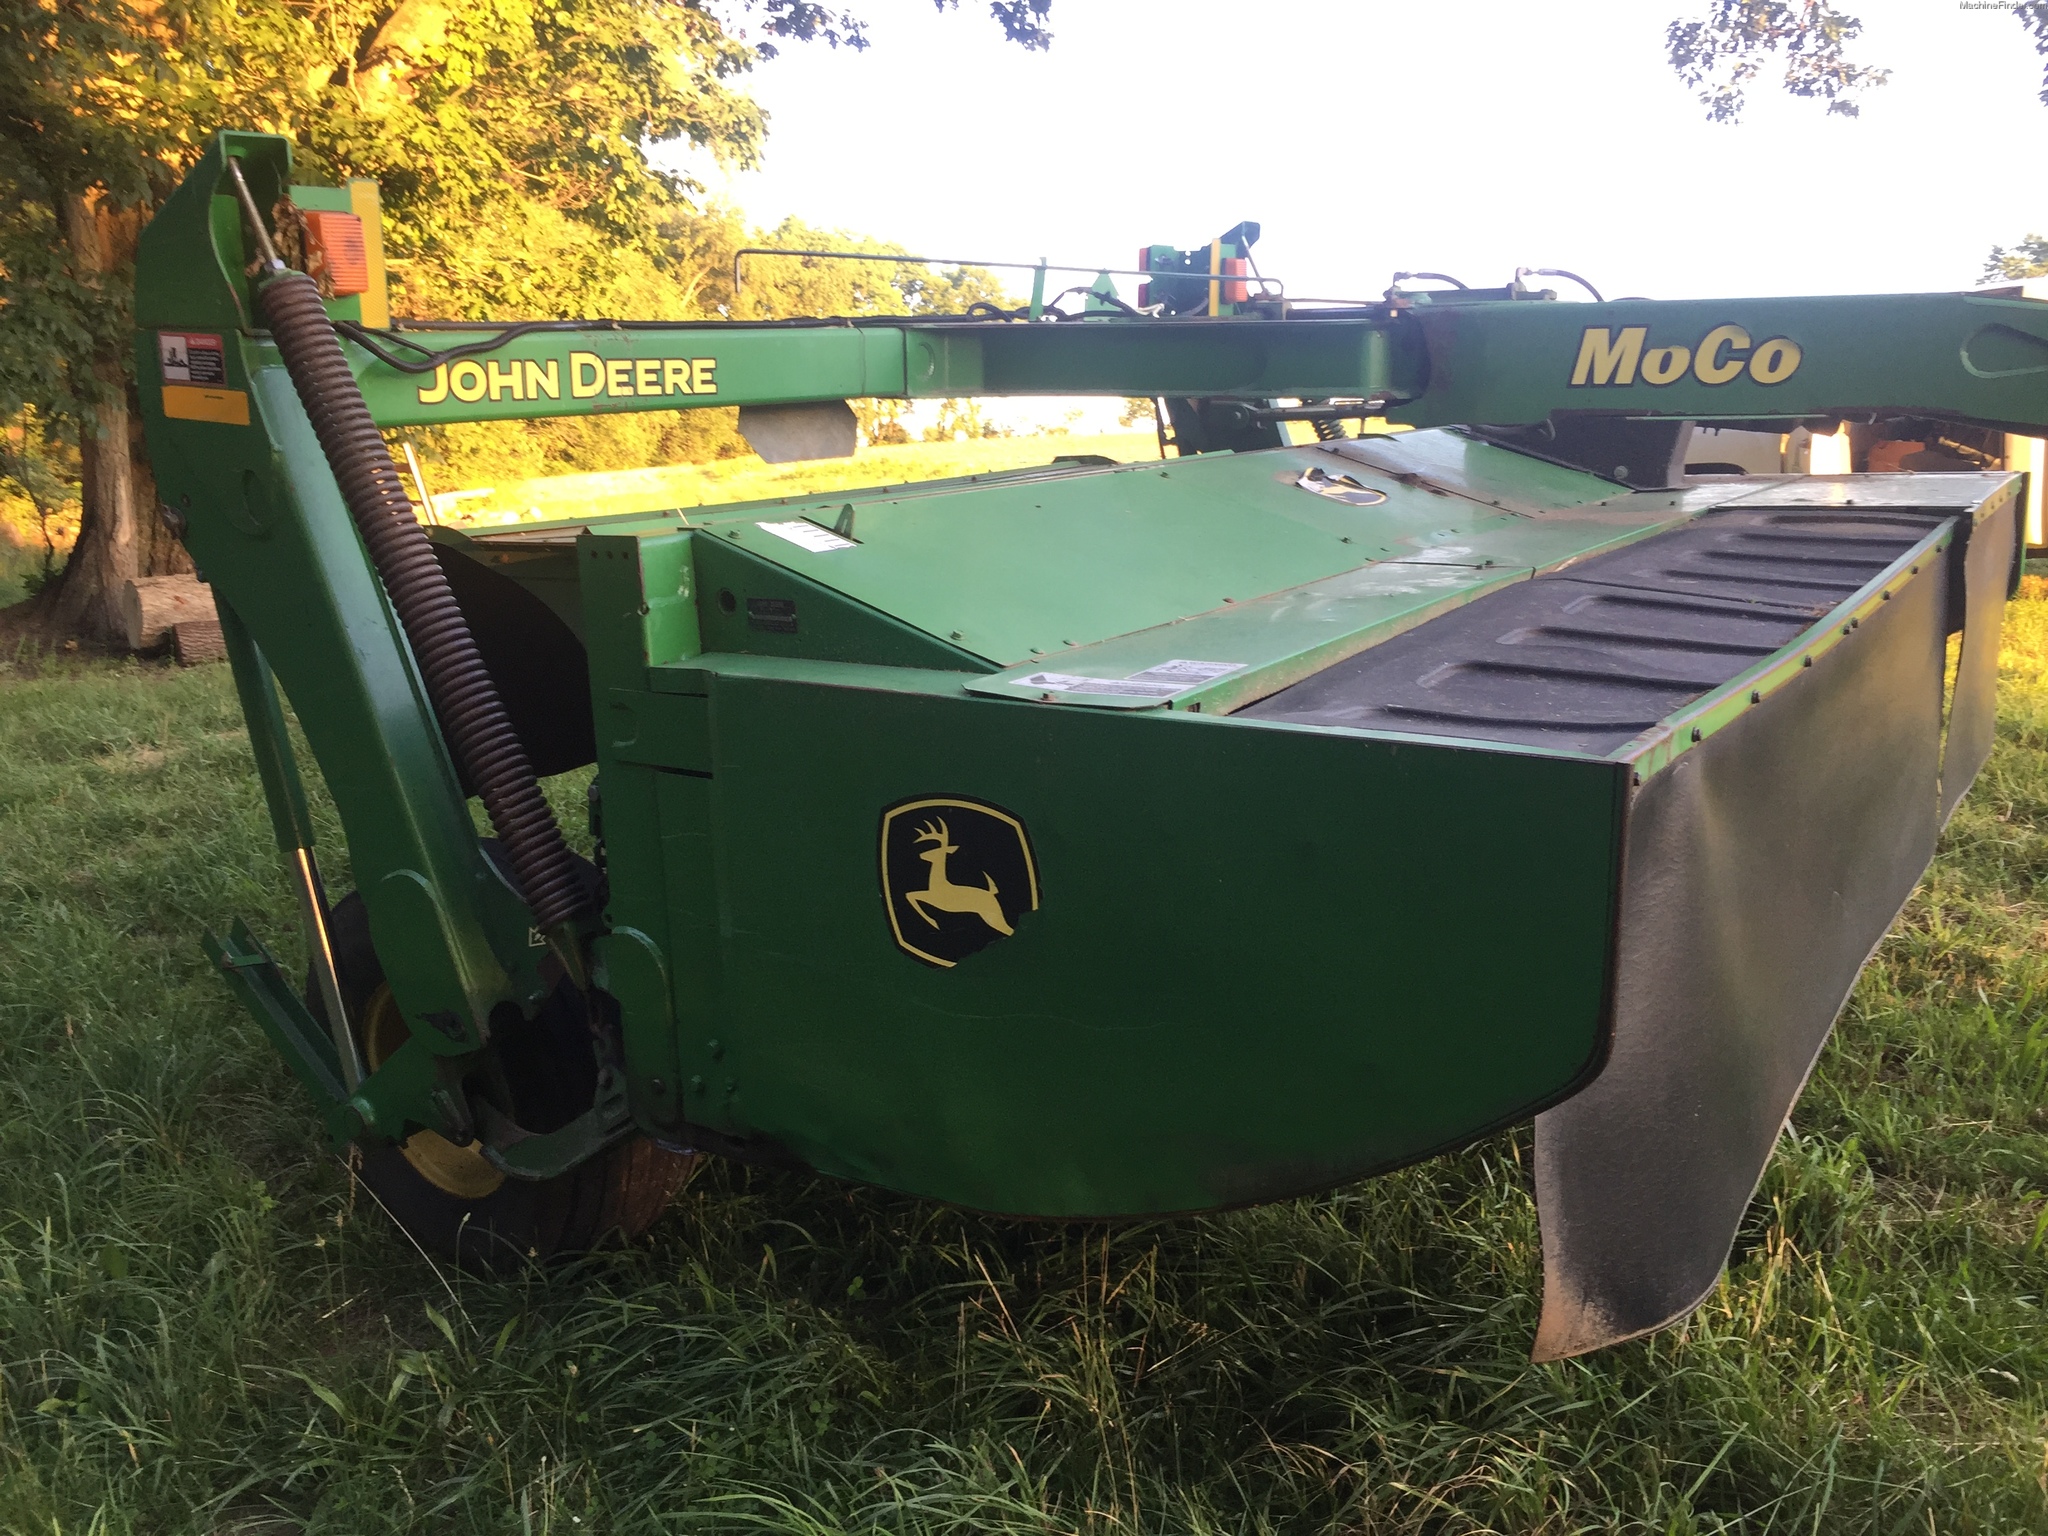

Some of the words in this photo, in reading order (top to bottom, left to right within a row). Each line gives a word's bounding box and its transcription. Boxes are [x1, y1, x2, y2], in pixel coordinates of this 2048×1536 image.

[417, 359, 560, 404] JOHN
[569, 350, 718, 398] DEERE
[1566, 321, 1803, 388] MoCo
